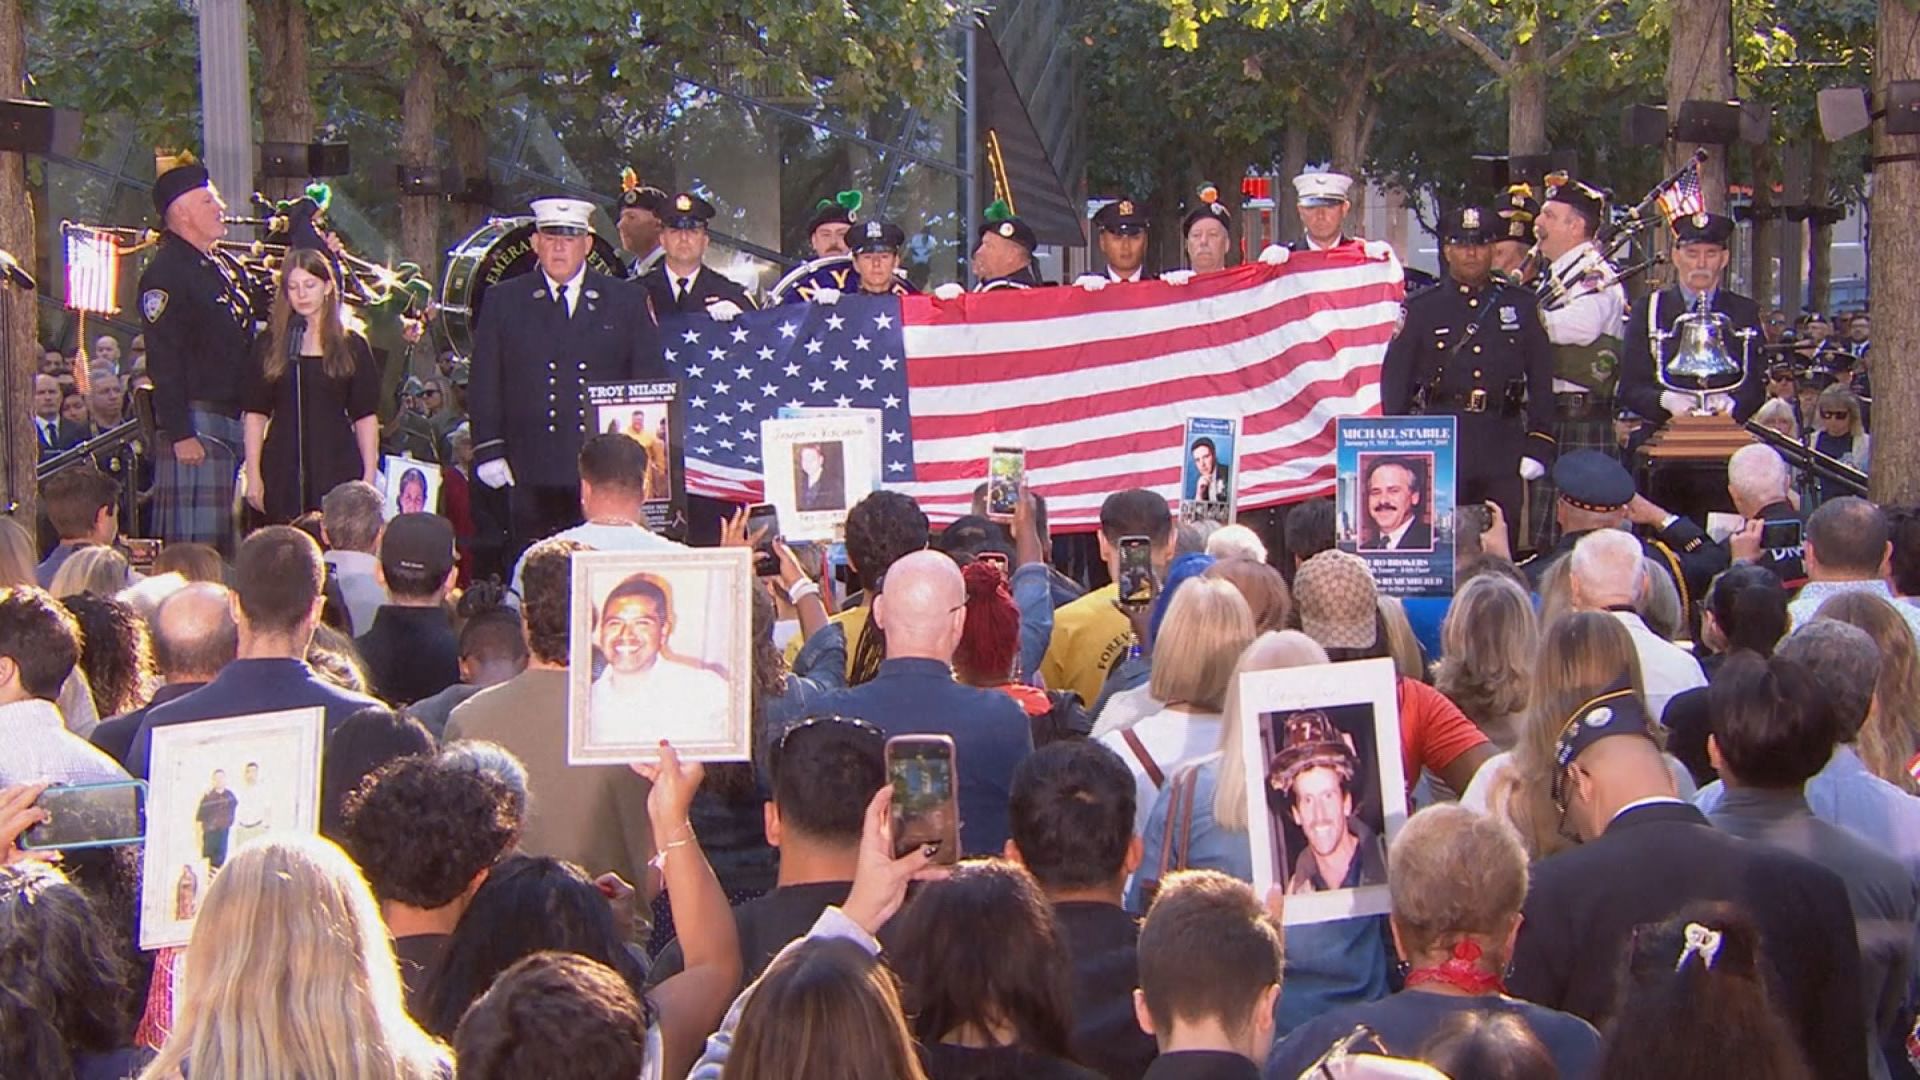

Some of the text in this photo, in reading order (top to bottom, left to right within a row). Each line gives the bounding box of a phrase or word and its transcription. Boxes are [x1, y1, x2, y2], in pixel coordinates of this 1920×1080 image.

[587, 250, 613, 277] ETY
[588, 382, 677, 399] TROY NILSEN
[1343, 427, 1450, 440] MICHAEL STABILE
[1387, 559, 1429, 567] BROKERS
[1097, 631, 1130, 670] FOREV
